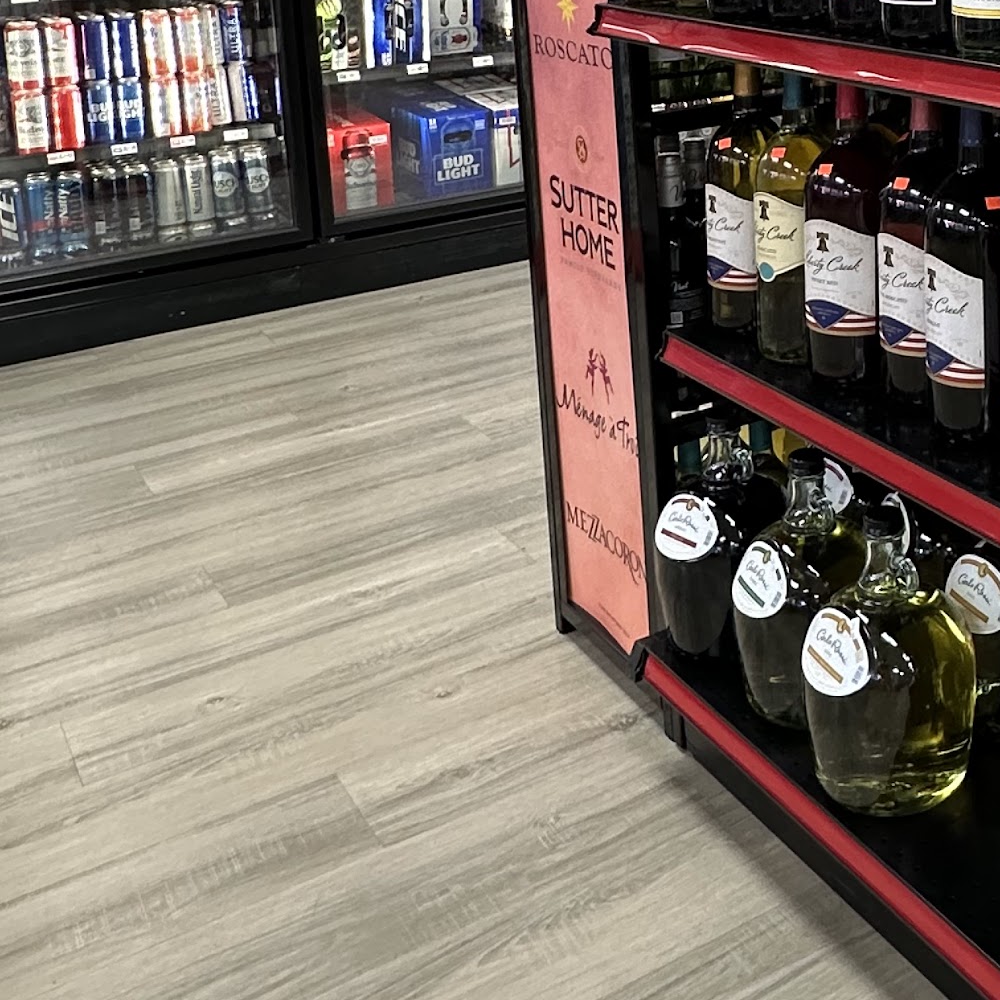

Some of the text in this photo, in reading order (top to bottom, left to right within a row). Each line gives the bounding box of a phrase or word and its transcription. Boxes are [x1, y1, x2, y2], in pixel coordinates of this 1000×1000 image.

[437, 163, 481, 182] LIGHT
[442, 153, 475, 170] BUD
[550, 175, 620, 234] SUTTER
[560, 217, 616, 271] HOME
[826, 256, 864, 273] Creek
[934, 297, 969, 319] Creek
[557, 383, 607, 440] Ménage
